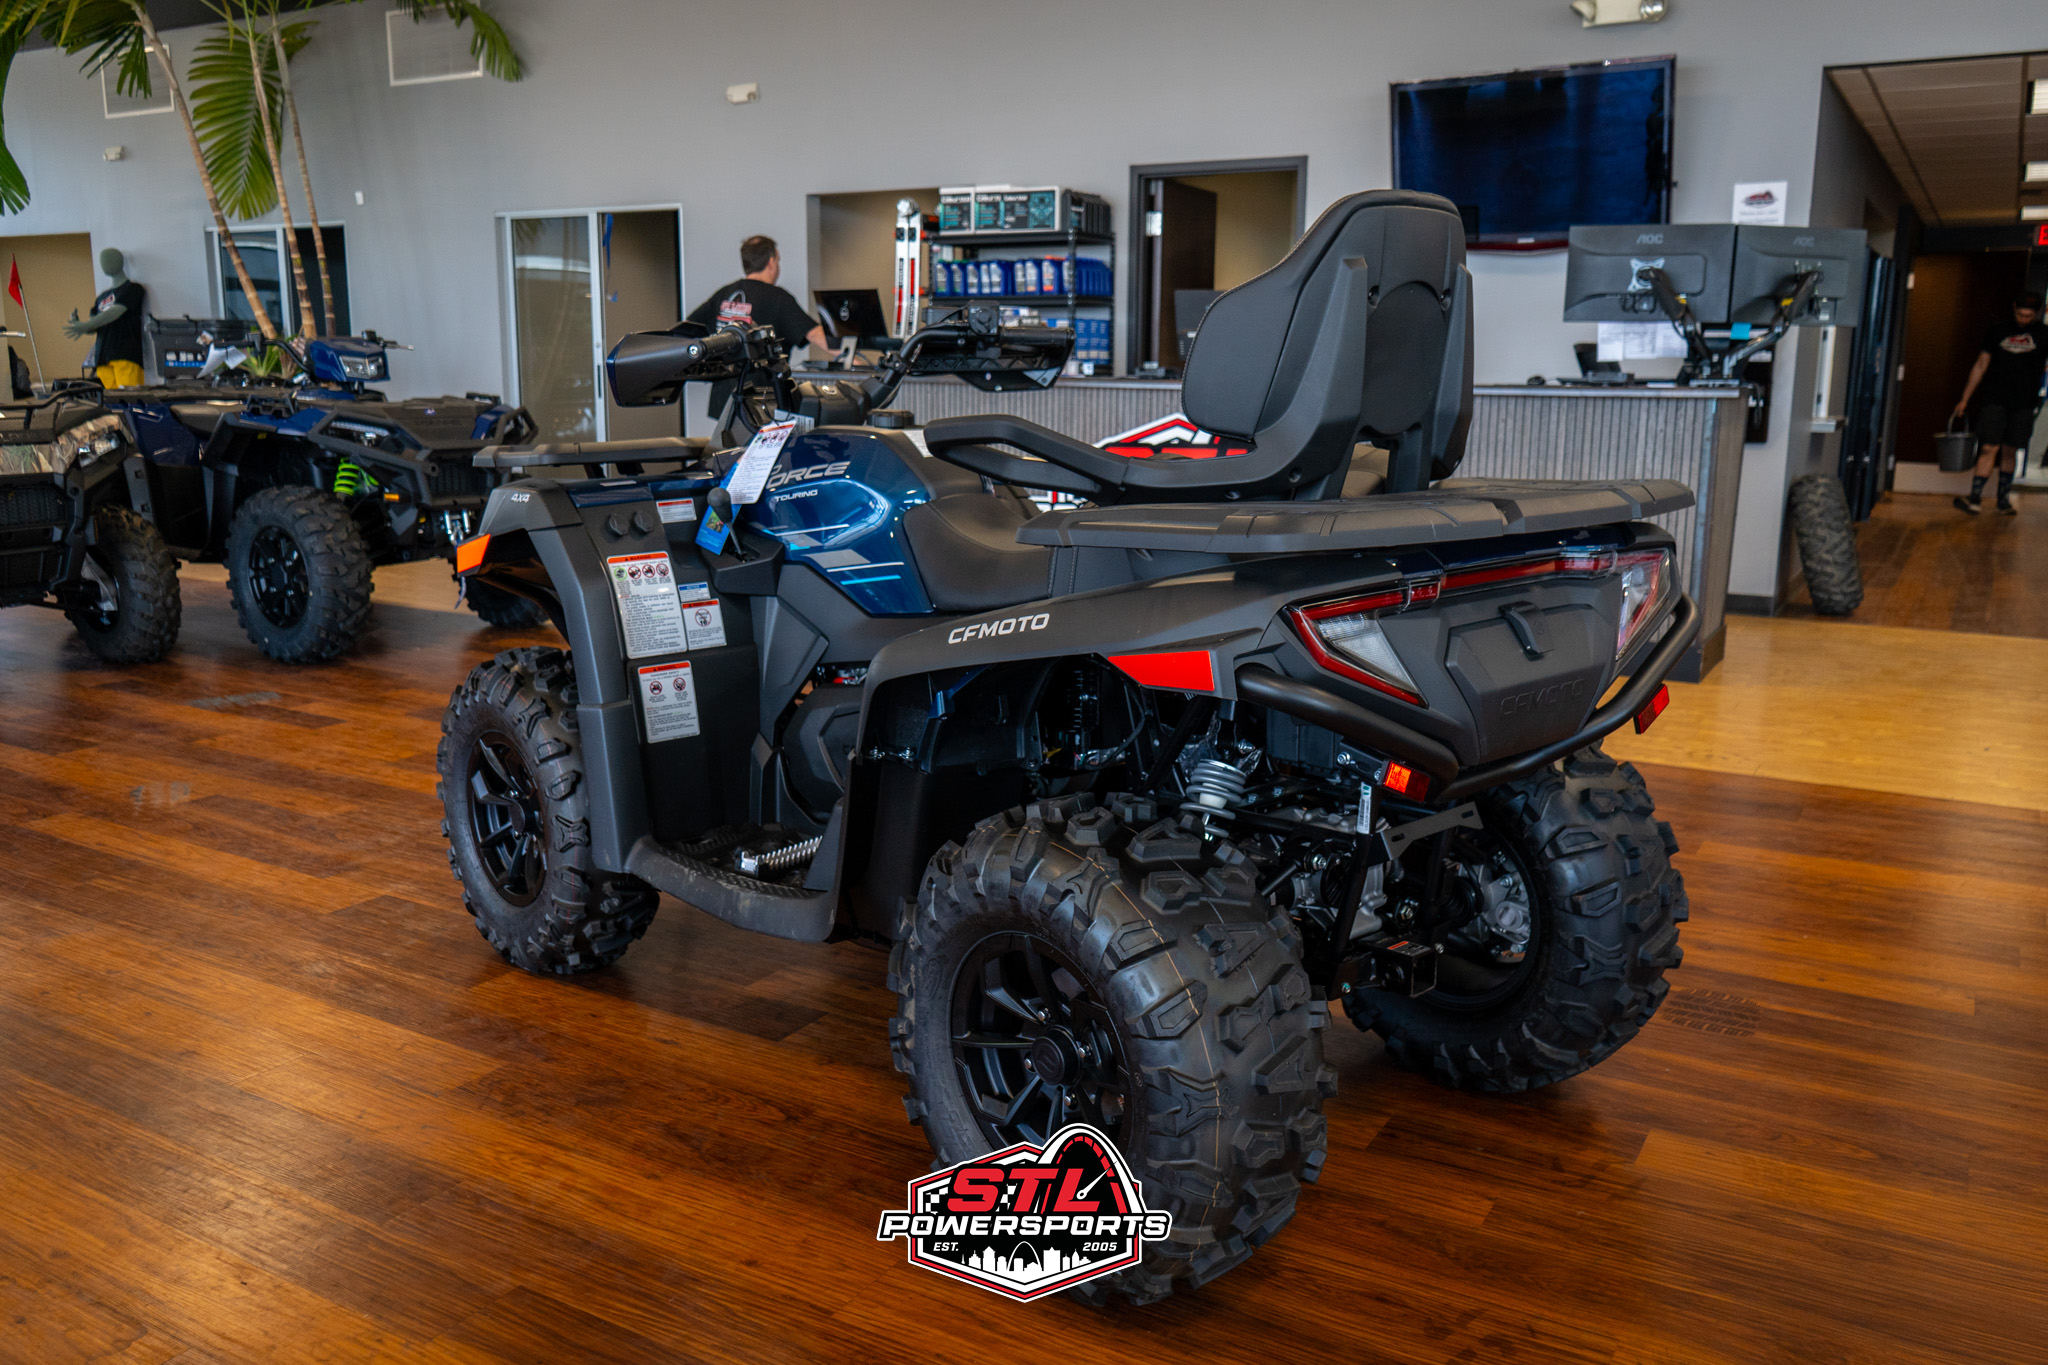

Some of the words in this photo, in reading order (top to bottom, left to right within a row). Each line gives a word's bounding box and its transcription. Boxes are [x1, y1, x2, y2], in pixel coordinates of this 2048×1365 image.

[1636, 232, 1664, 245] AOC
[1793, 234, 1816, 248] AOC
[766, 461, 851, 490] ORCE
[511, 493, 531, 503] 4X4
[774, 489, 819, 502] TOURING
[948, 613, 1050, 645] CFMOTO
